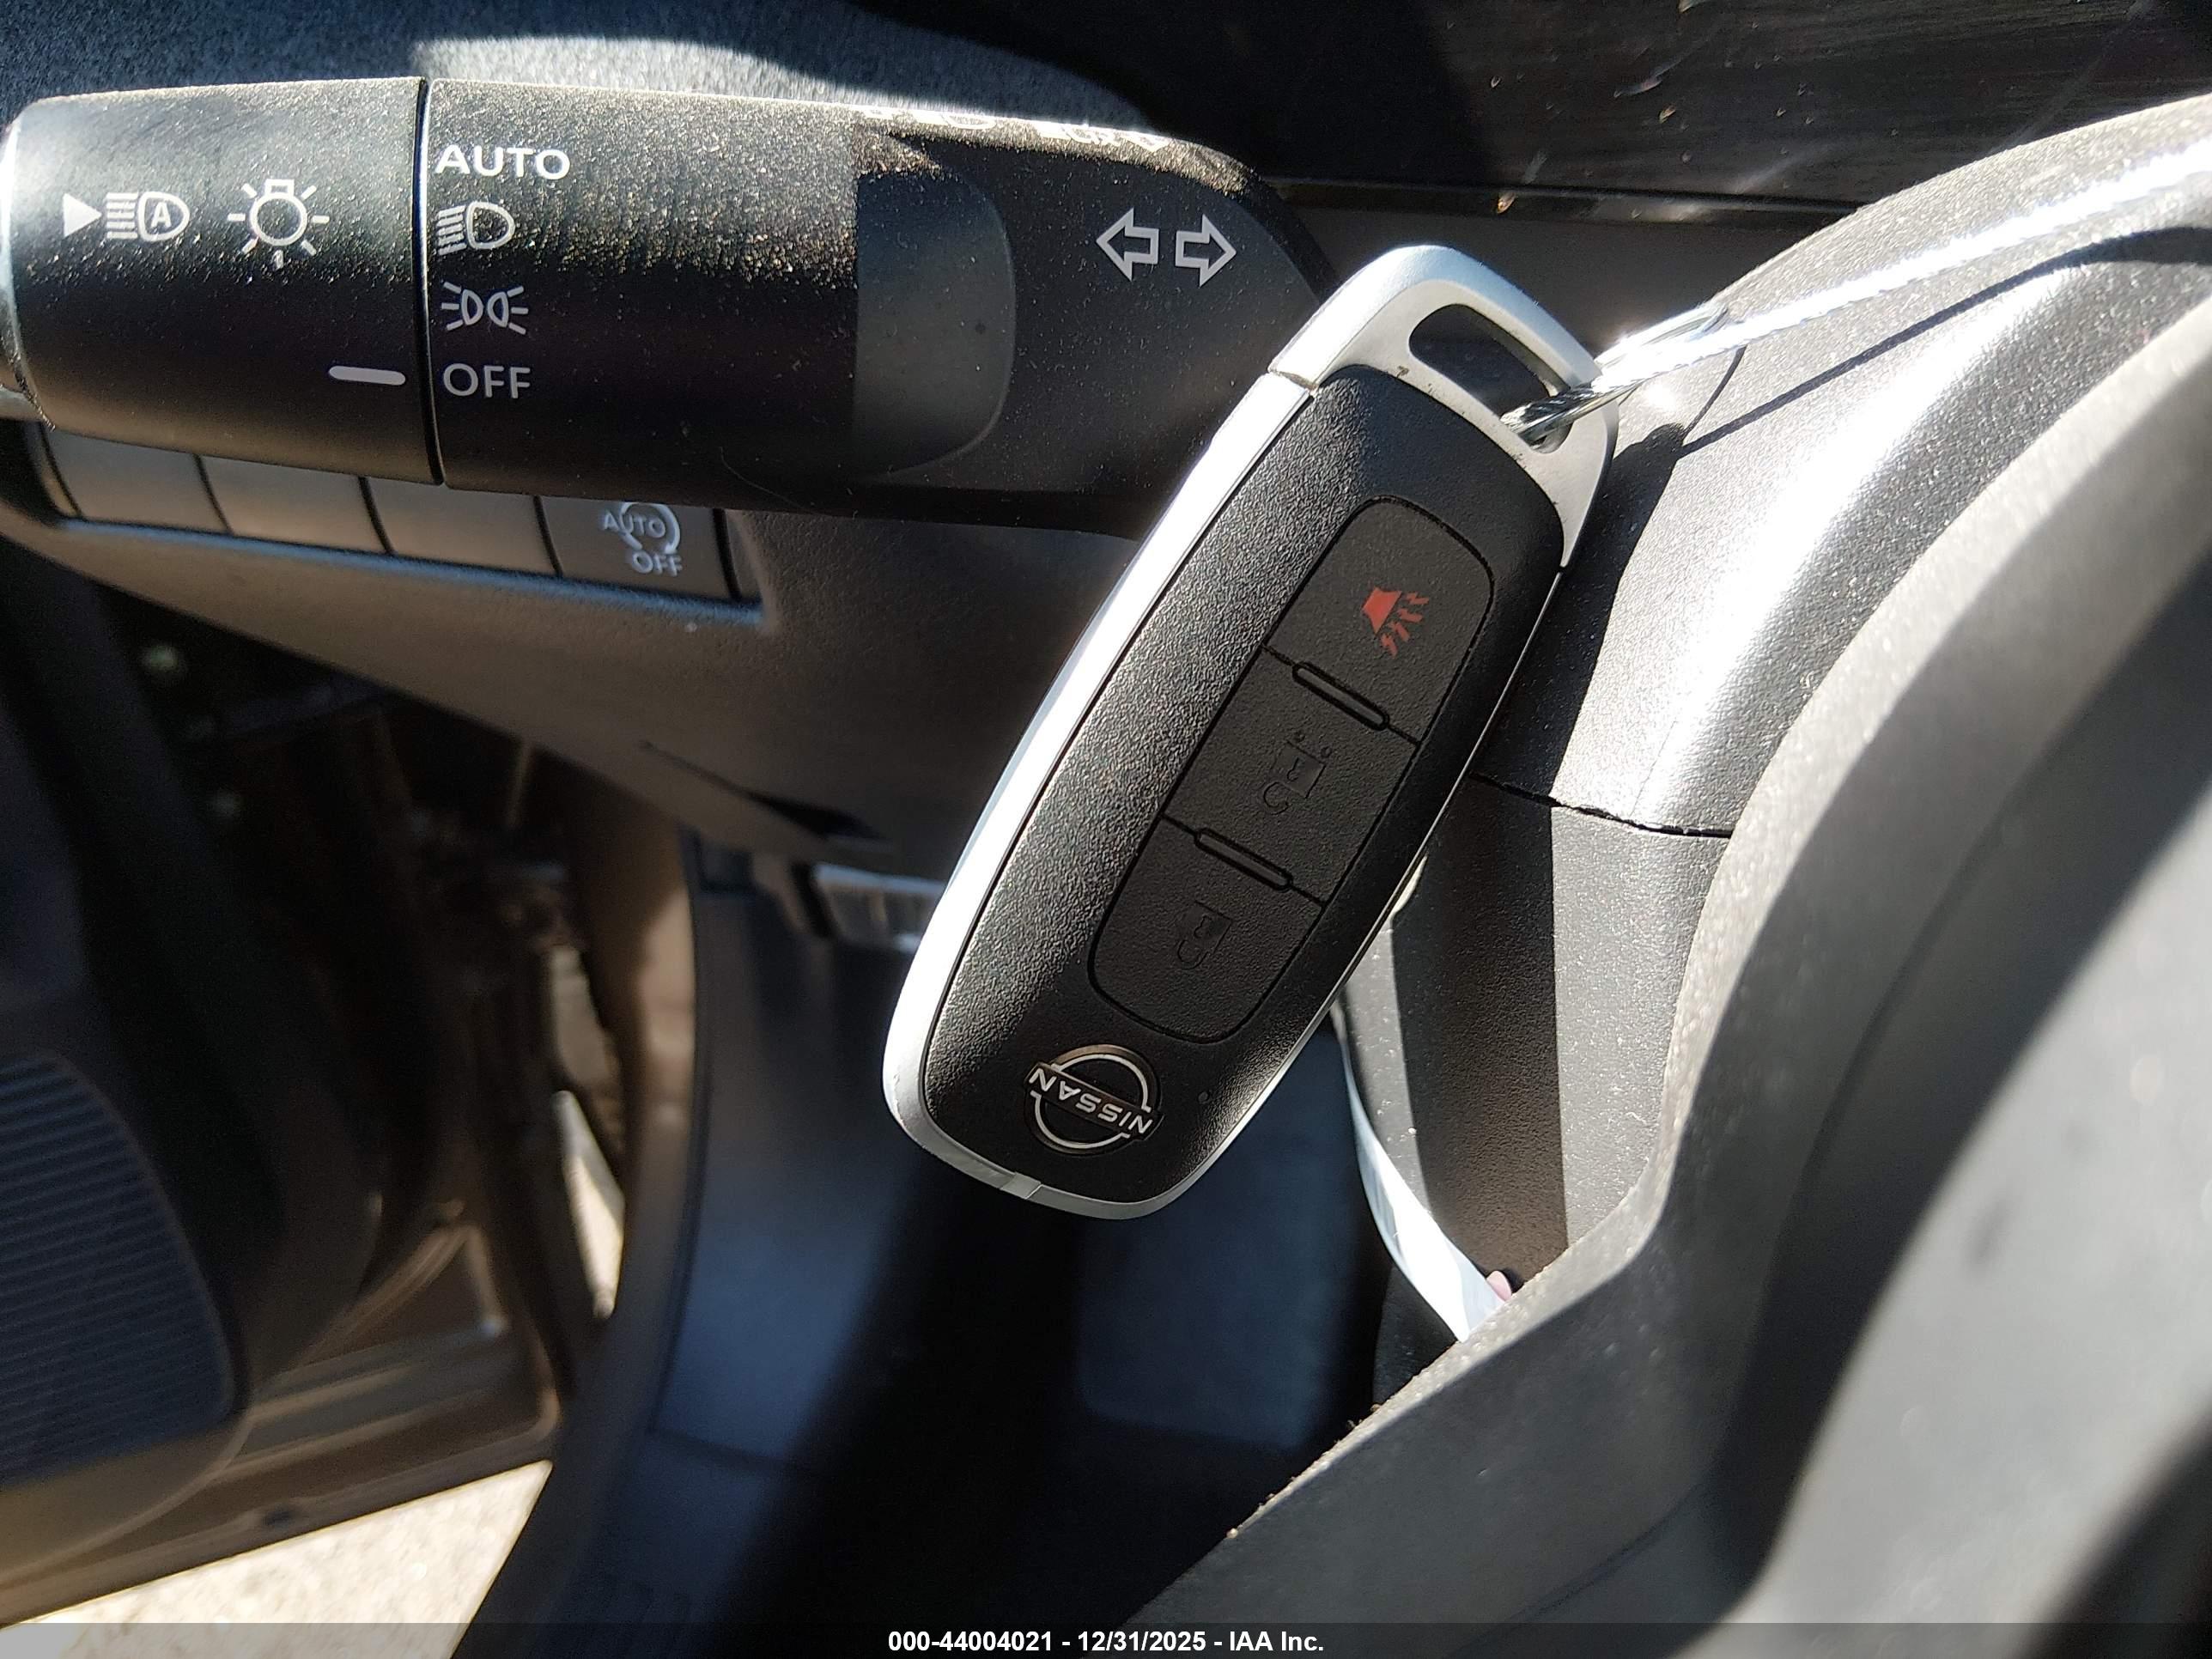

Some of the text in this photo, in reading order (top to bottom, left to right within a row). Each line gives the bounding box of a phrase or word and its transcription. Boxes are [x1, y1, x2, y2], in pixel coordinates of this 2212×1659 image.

[434, 143, 571, 180] AUTO
[442, 362, 532, 399] OFF
[603, 510, 667, 538] AUTO
[630, 550, 684, 577] OFF
[1028, 1066, 1153, 1134] NISSAN
